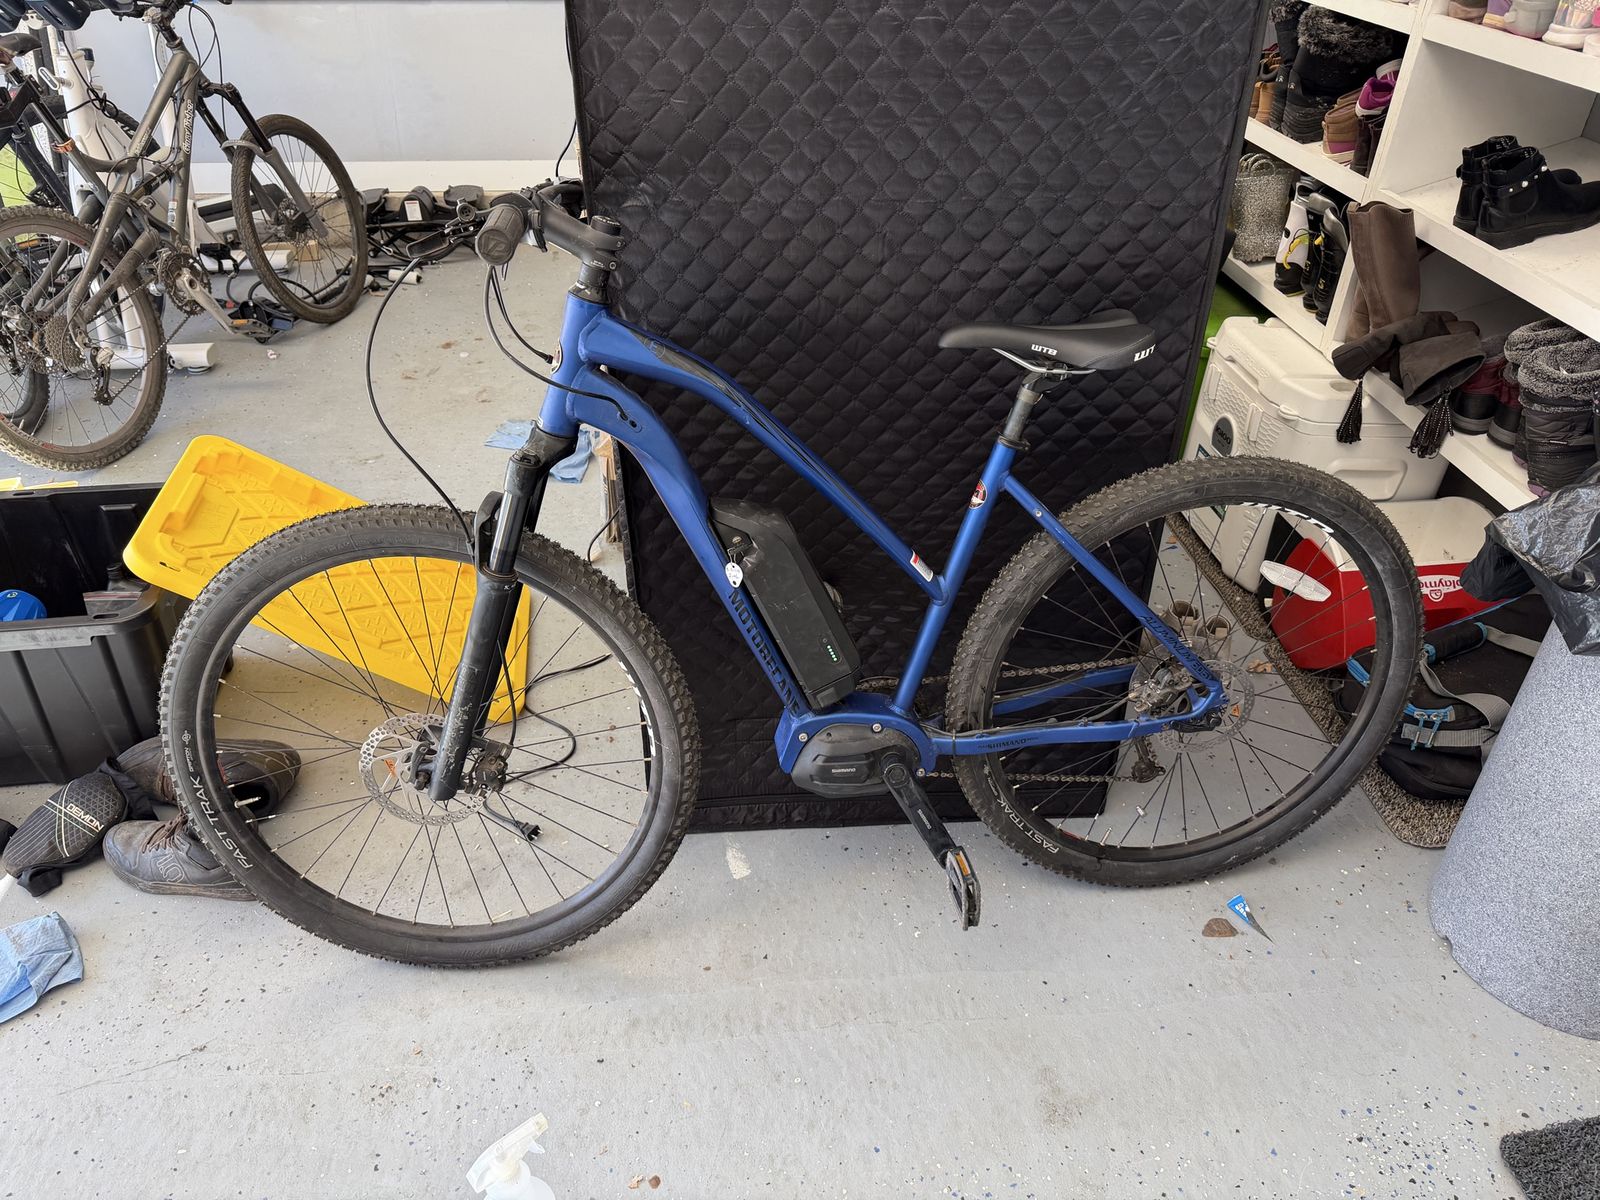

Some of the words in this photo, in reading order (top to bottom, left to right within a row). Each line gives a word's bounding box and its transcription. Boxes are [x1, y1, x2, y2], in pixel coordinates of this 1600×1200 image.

[1031, 343, 1058, 356] WTB
[1140, 615, 1196, 664] ALUMINUM
[987, 738, 1027, 749] SHIMANO
[189, 775, 219, 826] TRAK
[996, 798, 1025, 831] TRAK
[66, 803, 105, 831] DEMON
[214, 828, 254, 869] FAST
[1024, 829, 1060, 855] FAST
